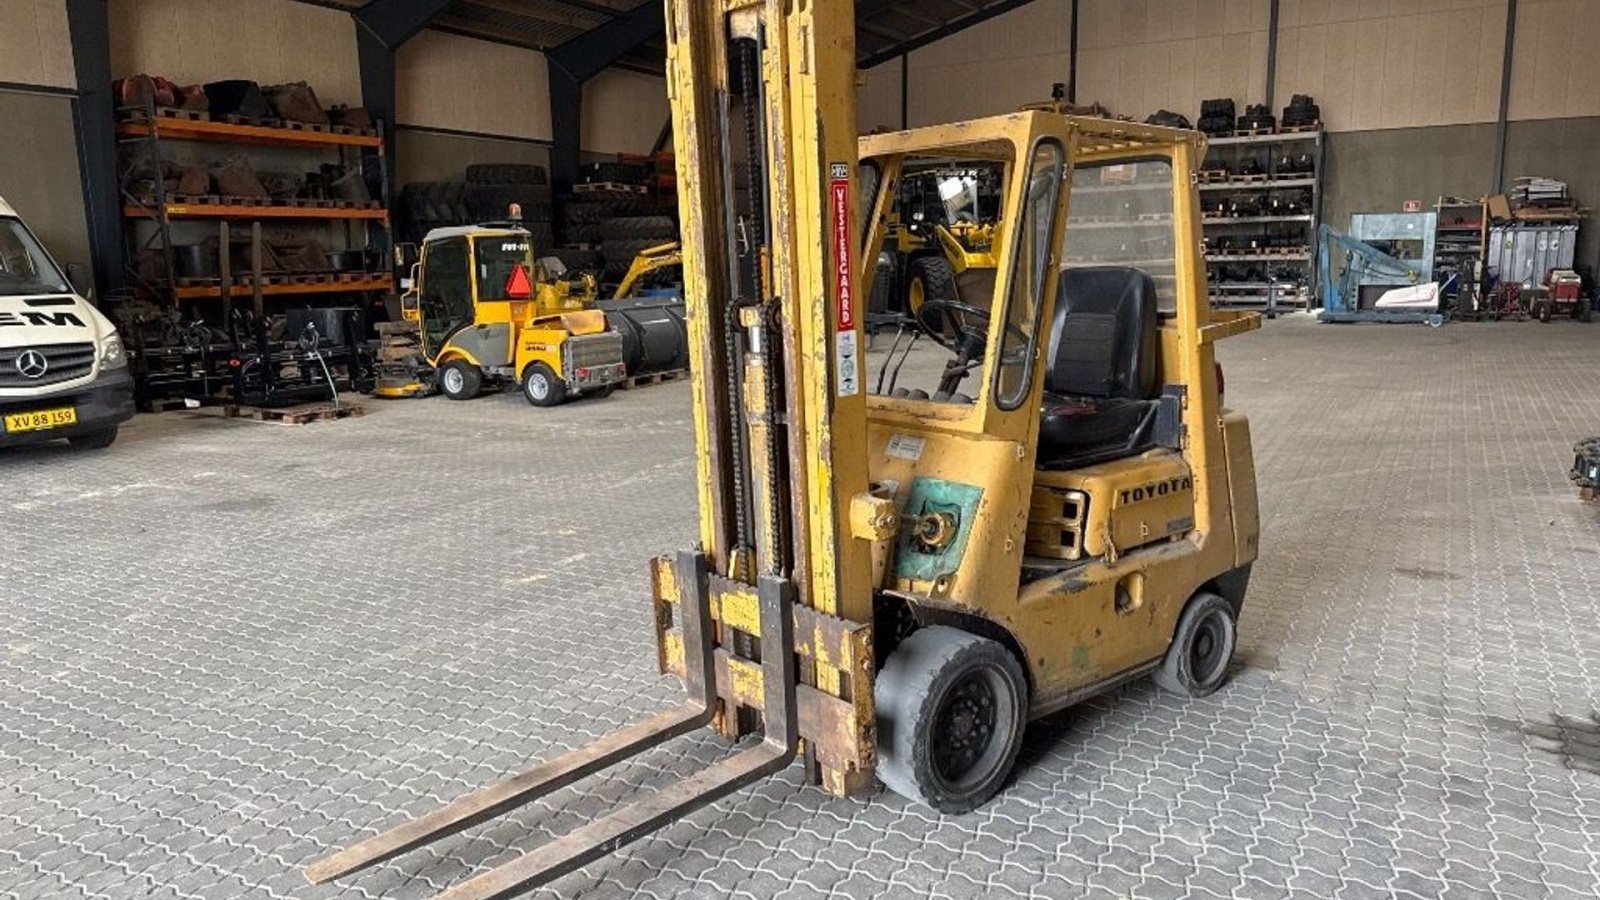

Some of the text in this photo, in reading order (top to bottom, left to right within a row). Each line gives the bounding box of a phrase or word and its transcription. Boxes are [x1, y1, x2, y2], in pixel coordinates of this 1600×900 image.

[836, 188, 850, 323] VESTERGAARD
[13, 410, 72, 429] XV 88 159
[1120, 476, 1191, 505] TOYOTA
